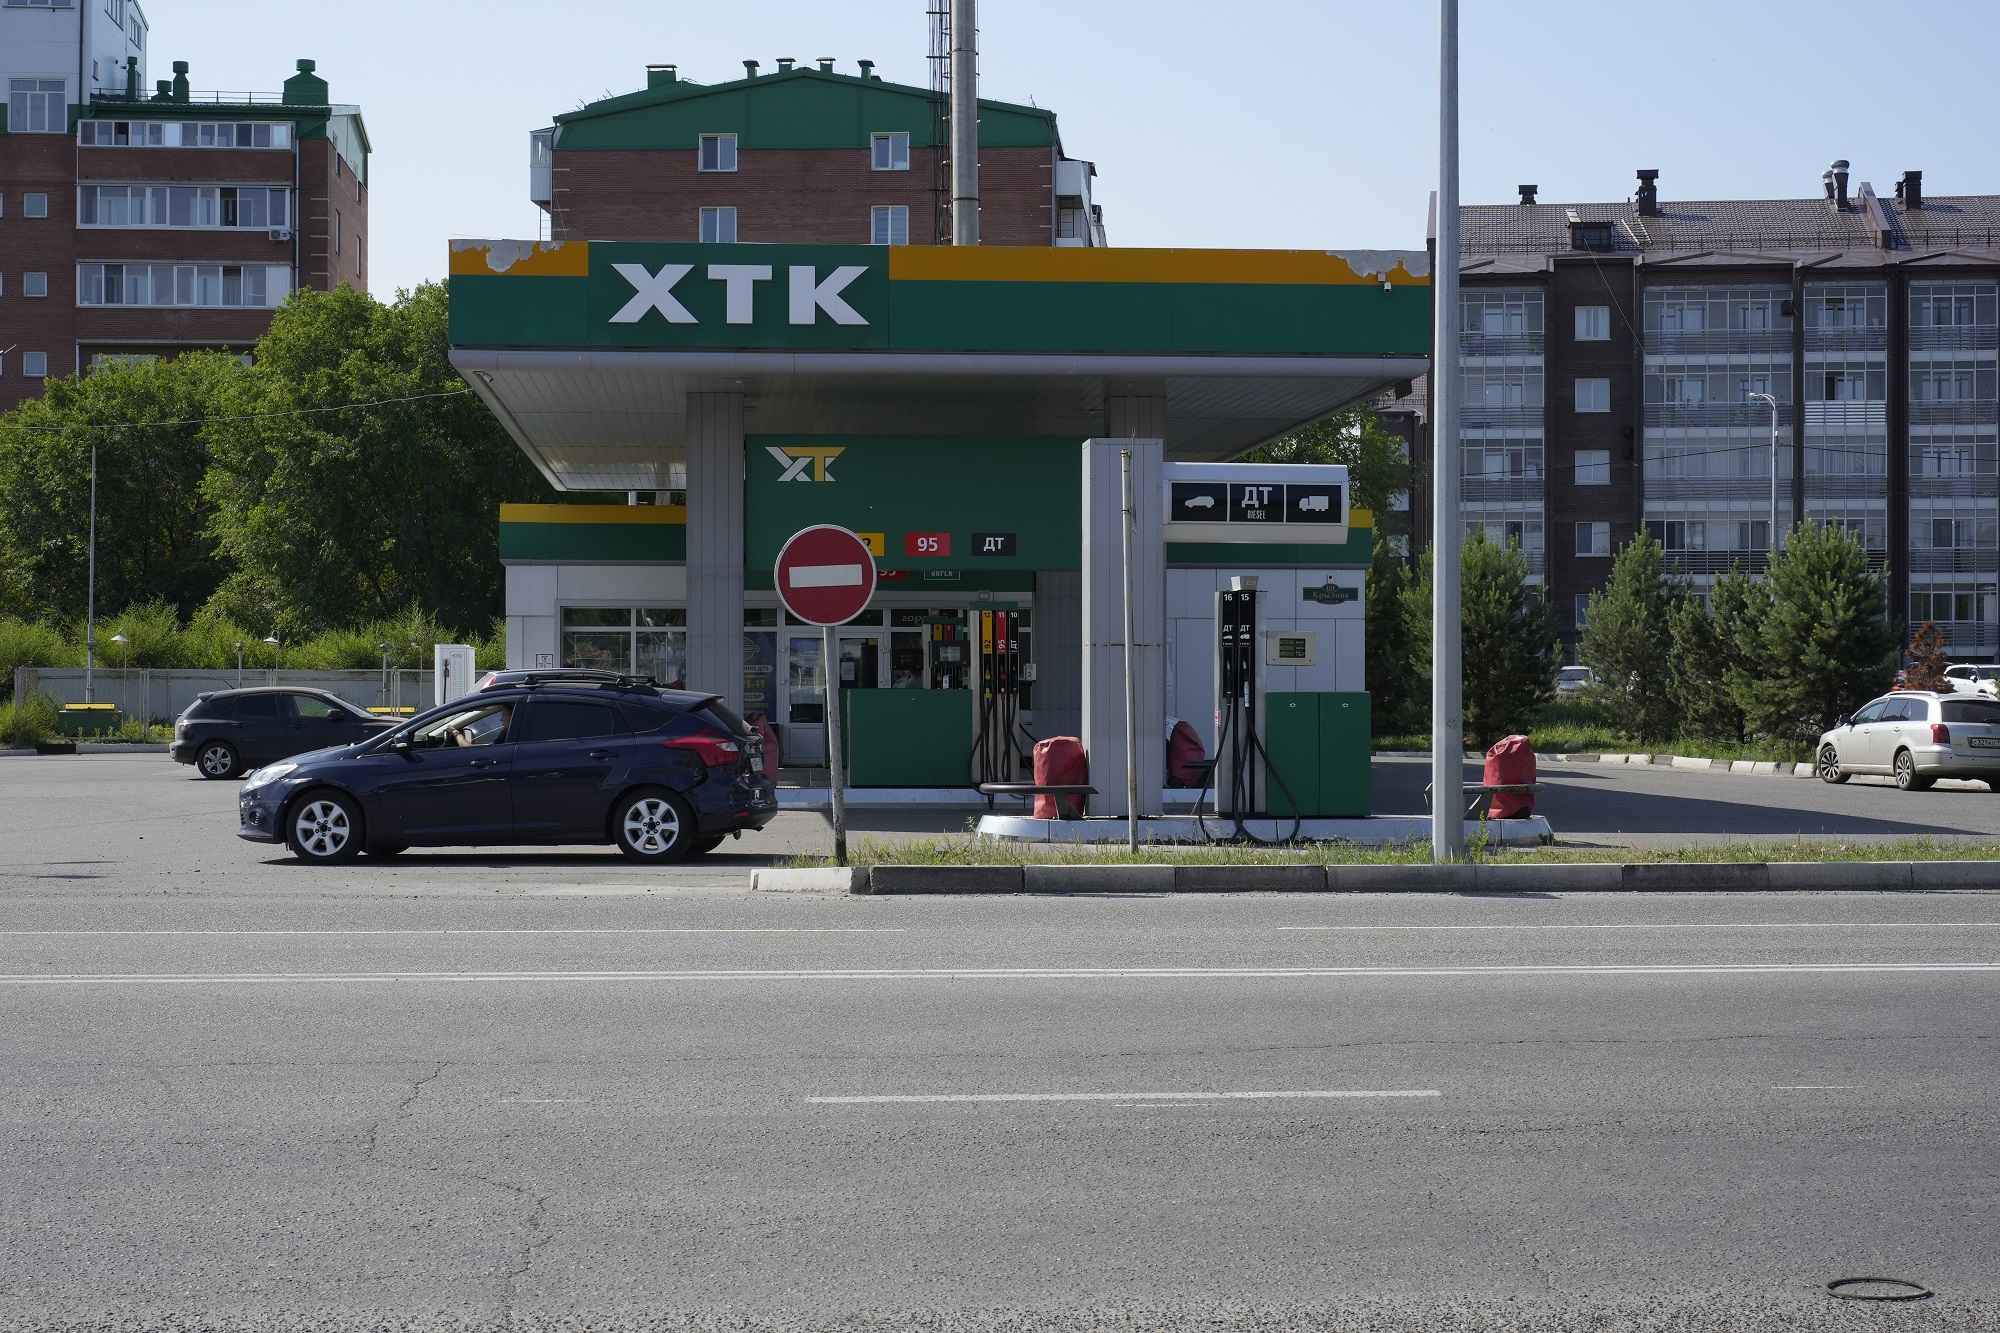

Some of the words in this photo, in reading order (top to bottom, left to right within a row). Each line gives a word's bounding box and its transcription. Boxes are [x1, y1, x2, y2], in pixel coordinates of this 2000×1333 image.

[607, 263, 871, 326] ХТК
[1241, 486, 1273, 508] ДТ
[1247, 510, 1266, 520] DIESEL
[917, 537, 938, 552] 95
[983, 537, 1004, 552] ДТ
[1223, 593, 1233, 601] 16
[1240, 593, 1250, 601] 15
[1312, 592, 1349, 600] Крылова
[984, 639, 991, 649] 92
[998, 639, 1005, 649] 95
[1010, 639, 1018, 650] ДТ
